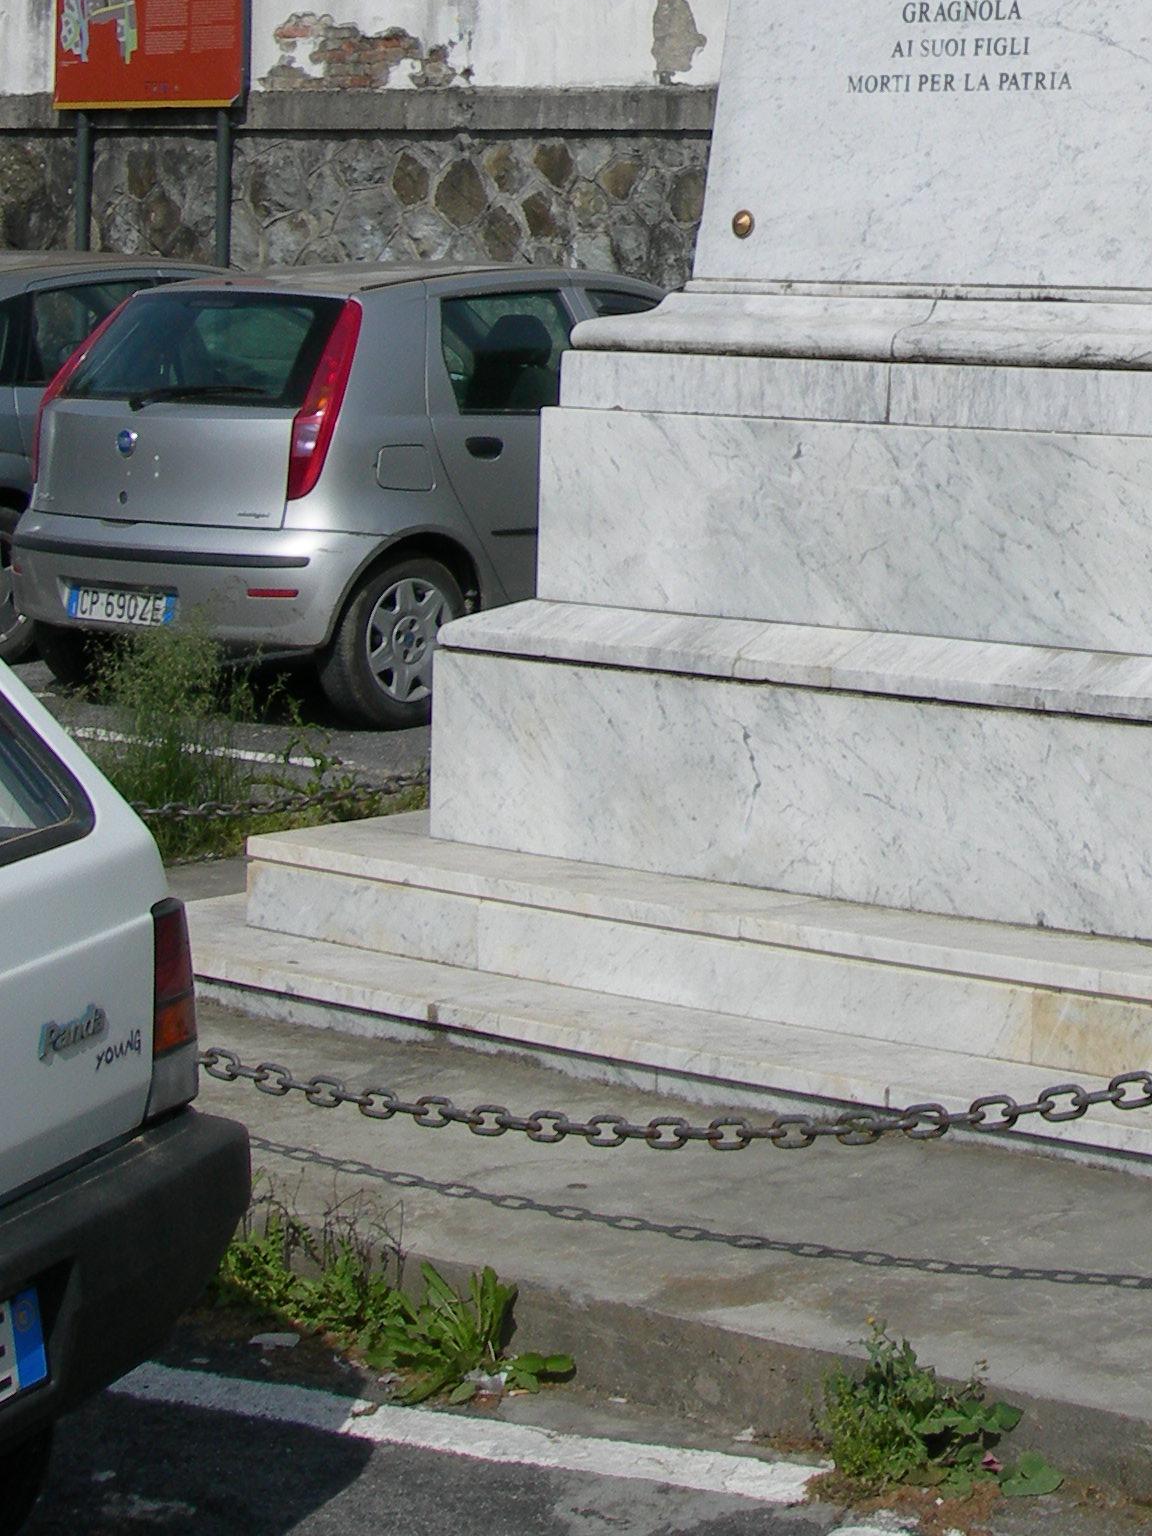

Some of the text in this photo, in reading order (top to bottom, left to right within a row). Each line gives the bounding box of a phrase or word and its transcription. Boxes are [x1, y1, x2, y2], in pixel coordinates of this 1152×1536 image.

[902, 0, 1022, 24] GRAGNOLA
[891, 36, 1031, 58] AI SUOI FIGLI
[847, 71, 1073, 94] MORTI PER LA PATRIA
[40, 1004, 108, 1064] Panda
[95, 1028, 142, 1072] YOUNG
